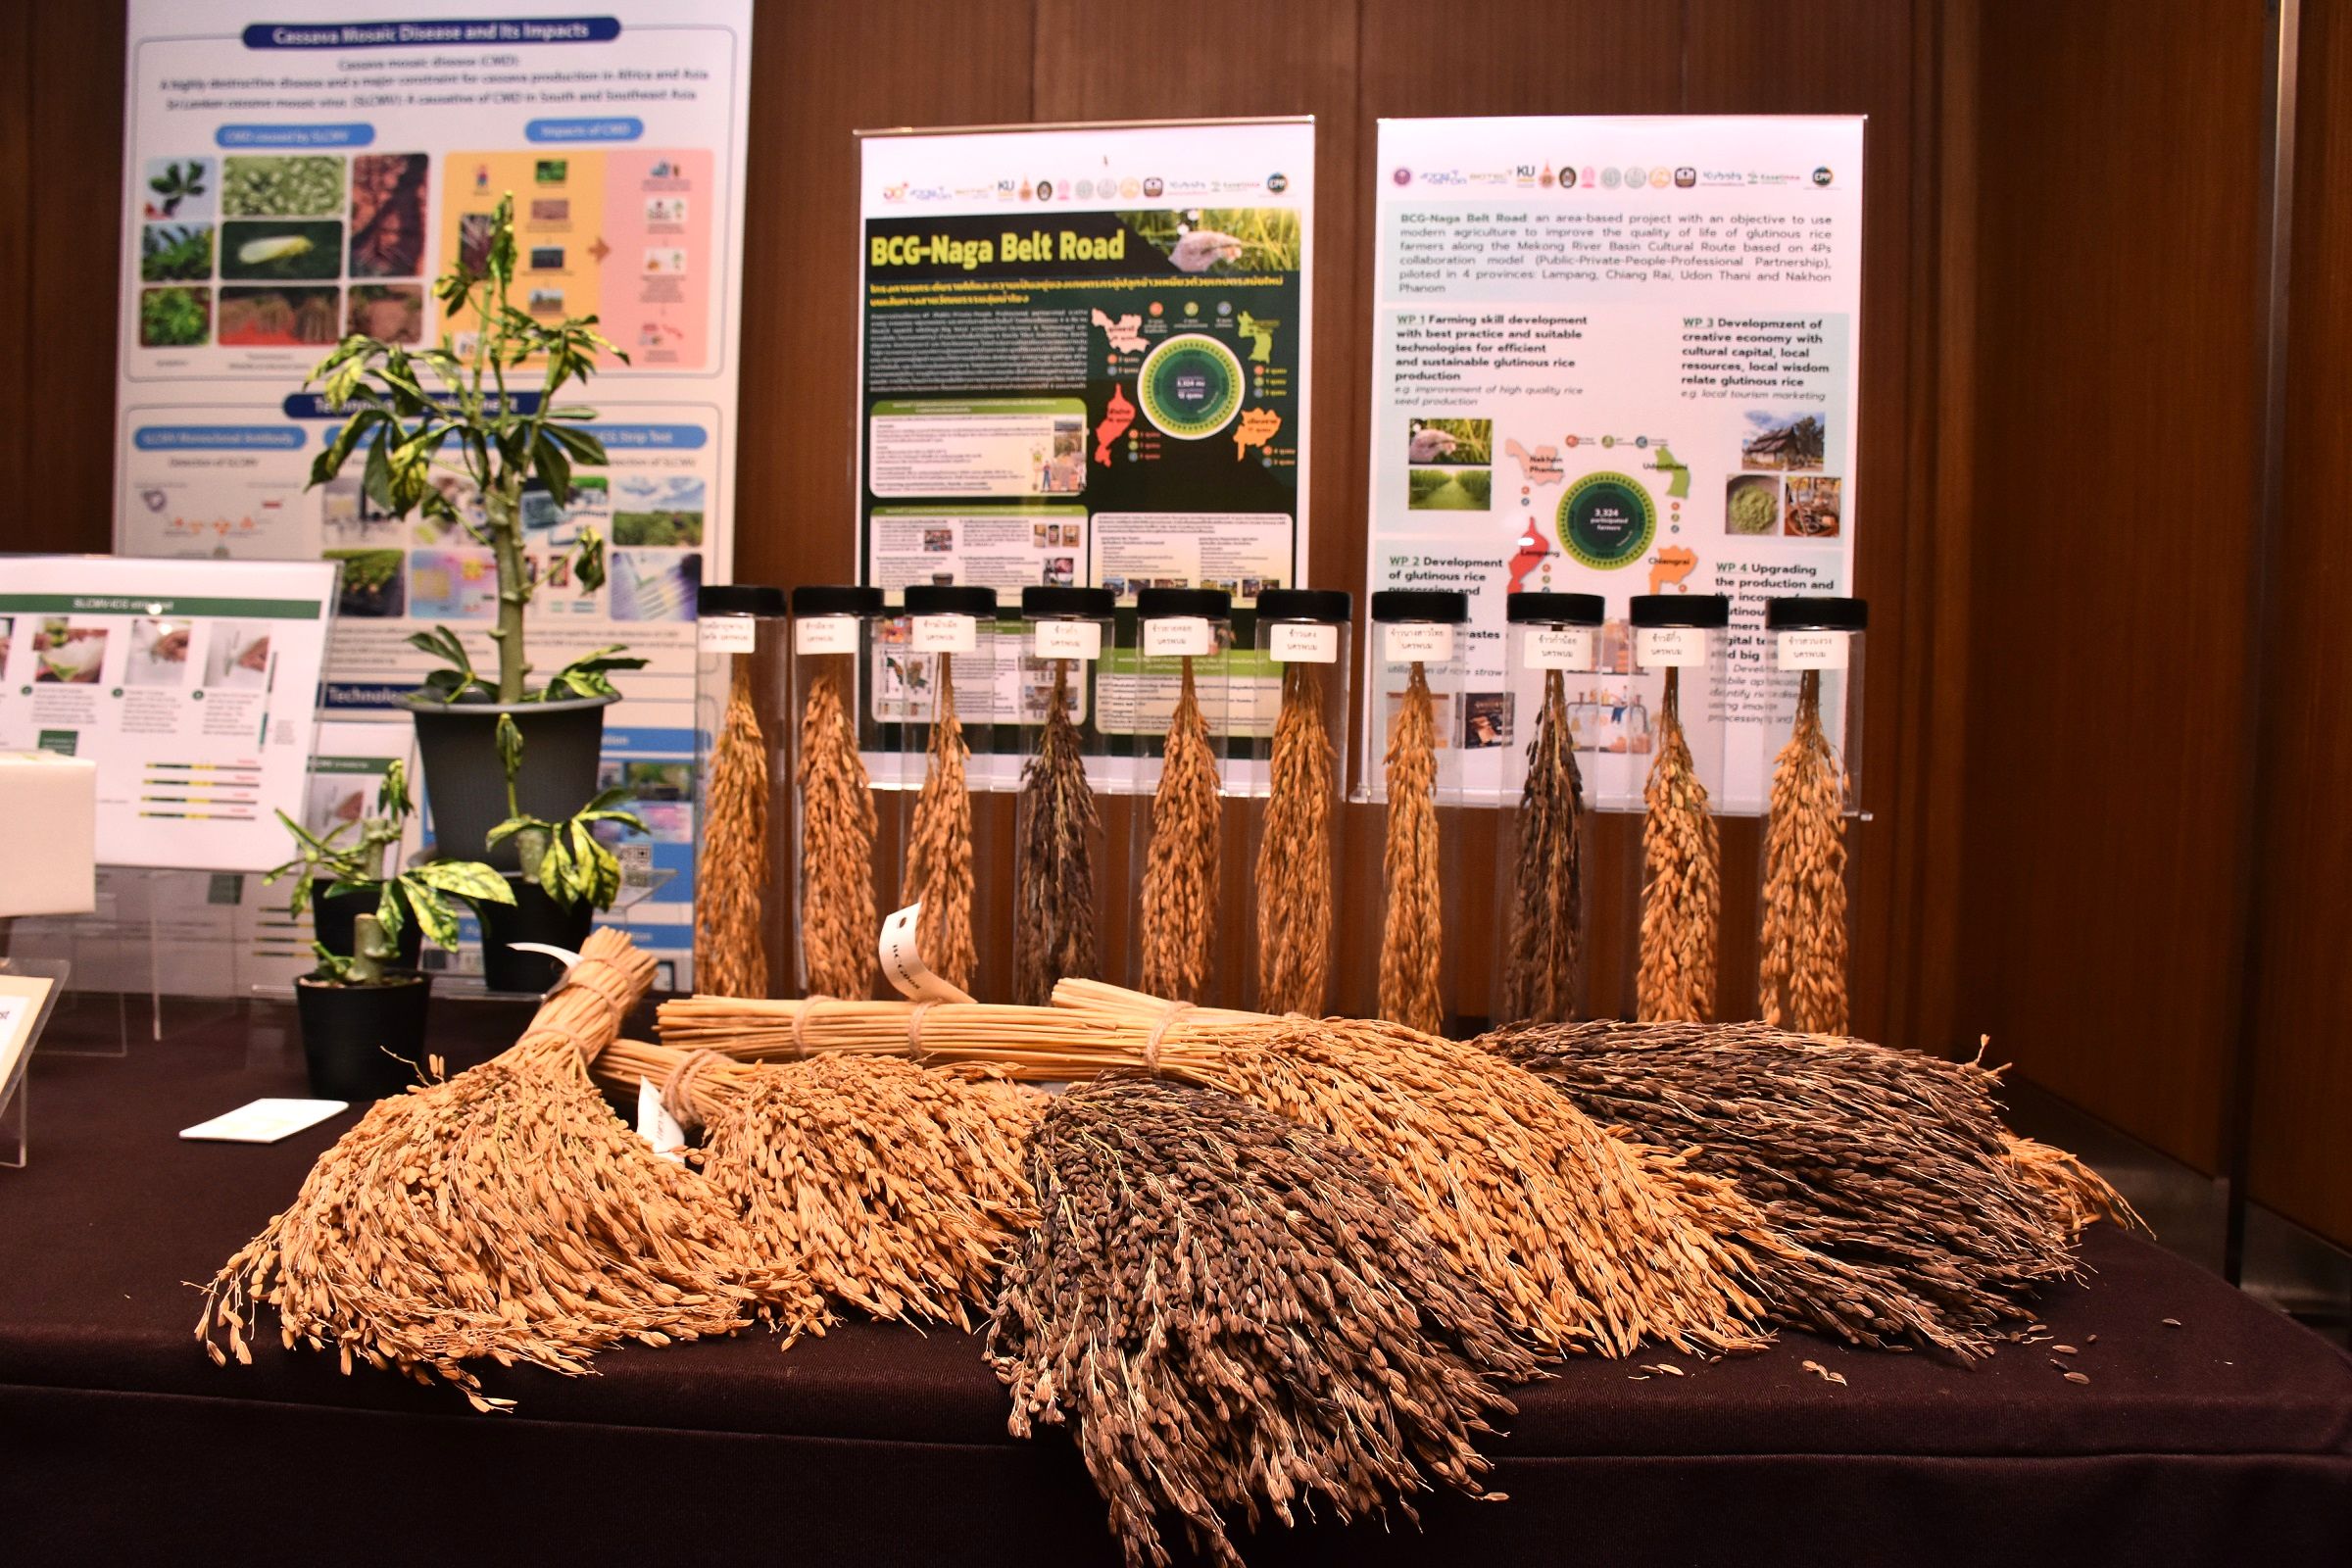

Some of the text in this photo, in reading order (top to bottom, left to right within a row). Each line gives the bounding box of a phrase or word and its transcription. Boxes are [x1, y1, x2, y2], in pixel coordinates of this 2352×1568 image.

[272, 22, 589, 45] Cassava Mosaic Disease and Its Impacts
[1400, 214, 1460, 224] BCG-Naga
[1467, 214, 1490, 222] Belt
[1556, 214, 1623, 223] area-based
[1629, 214, 1672, 225] project
[1678, 215, 1703, 223] with
[1730, 215, 1786, 226] objective
[1792, 215, 1805, 223] to
[1399, 228, 1832, 241] modern agriculture to improve the quality of life of glutinous rice
[871, 228, 1125, 270] BCG-Naga Belt Road
[1399, 242, 1445, 251] farmers
[1451, 242, 1485, 253] along
[1491, 242, 1510, 251] the
[1517, 243, 1565, 254] Mekong
[1572, 243, 1601, 252] River
[1609, 243, 1641, 252] Basin
[1647, 243, 1693, 252] Cultural
[1700, 243, 1736, 252] Route
[1810, 244, 1832, 253] 4Ps
[1399, 256, 1476, 266] collaboration
[1488, 256, 1524, 266] model
[1399, 270, 1441, 281] piloted
[1446, 270, 1457, 279] in
[1462, 270, 1470, 279] 4
[1605, 271, 1647, 282] Chiang
[1681, 271, 1713, 280] Udon
[1719, 271, 1750, 281] Thani
[1756, 271, 1780, 281] and
[1786, 272, 1832, 281] Nakhon
[1429, 316, 1477, 326] Farming
[1481, 316, 1504, 324] skill
[1508, 316, 1588, 326] development
[1683, 318, 1703, 327] WP
[1706, 318, 1714, 328] 3
[1809, 318, 1823, 329] of
[1396, 329, 1421, 338] with
[1425, 329, 1451, 338] best
[1455, 329, 1503, 340] practice
[1682, 333, 1823, 345] creative economy with
[1396, 344, 1546, 354] technologies for efficient
[1682, 347, 1810, 360] cultural capital, local
[1396, 358, 1576, 368] and sustainable glutinous rice
[1682, 363, 1830, 372] resources, local wisdom
[1395, 371, 1461, 382] production
[1681, 376, 1804, 388] relate glutinous rice
[1415, 385, 1482, 395] improvement
[1499, 386, 1522, 396] high
[1525, 386, 1561, 396] quality
[1422, 398, 1478, 408] production
[1772, 392, 1826, 402] marketing
[1390, 557, 1503, 569] WP 2 Development
[1716, 563, 1817, 575] WP 4 Upgrading
[1389, 570, 1487, 583] of glutinous rice
[1715, 577, 1835, 590] the production and
[1740, 651, 1760, 662] big
